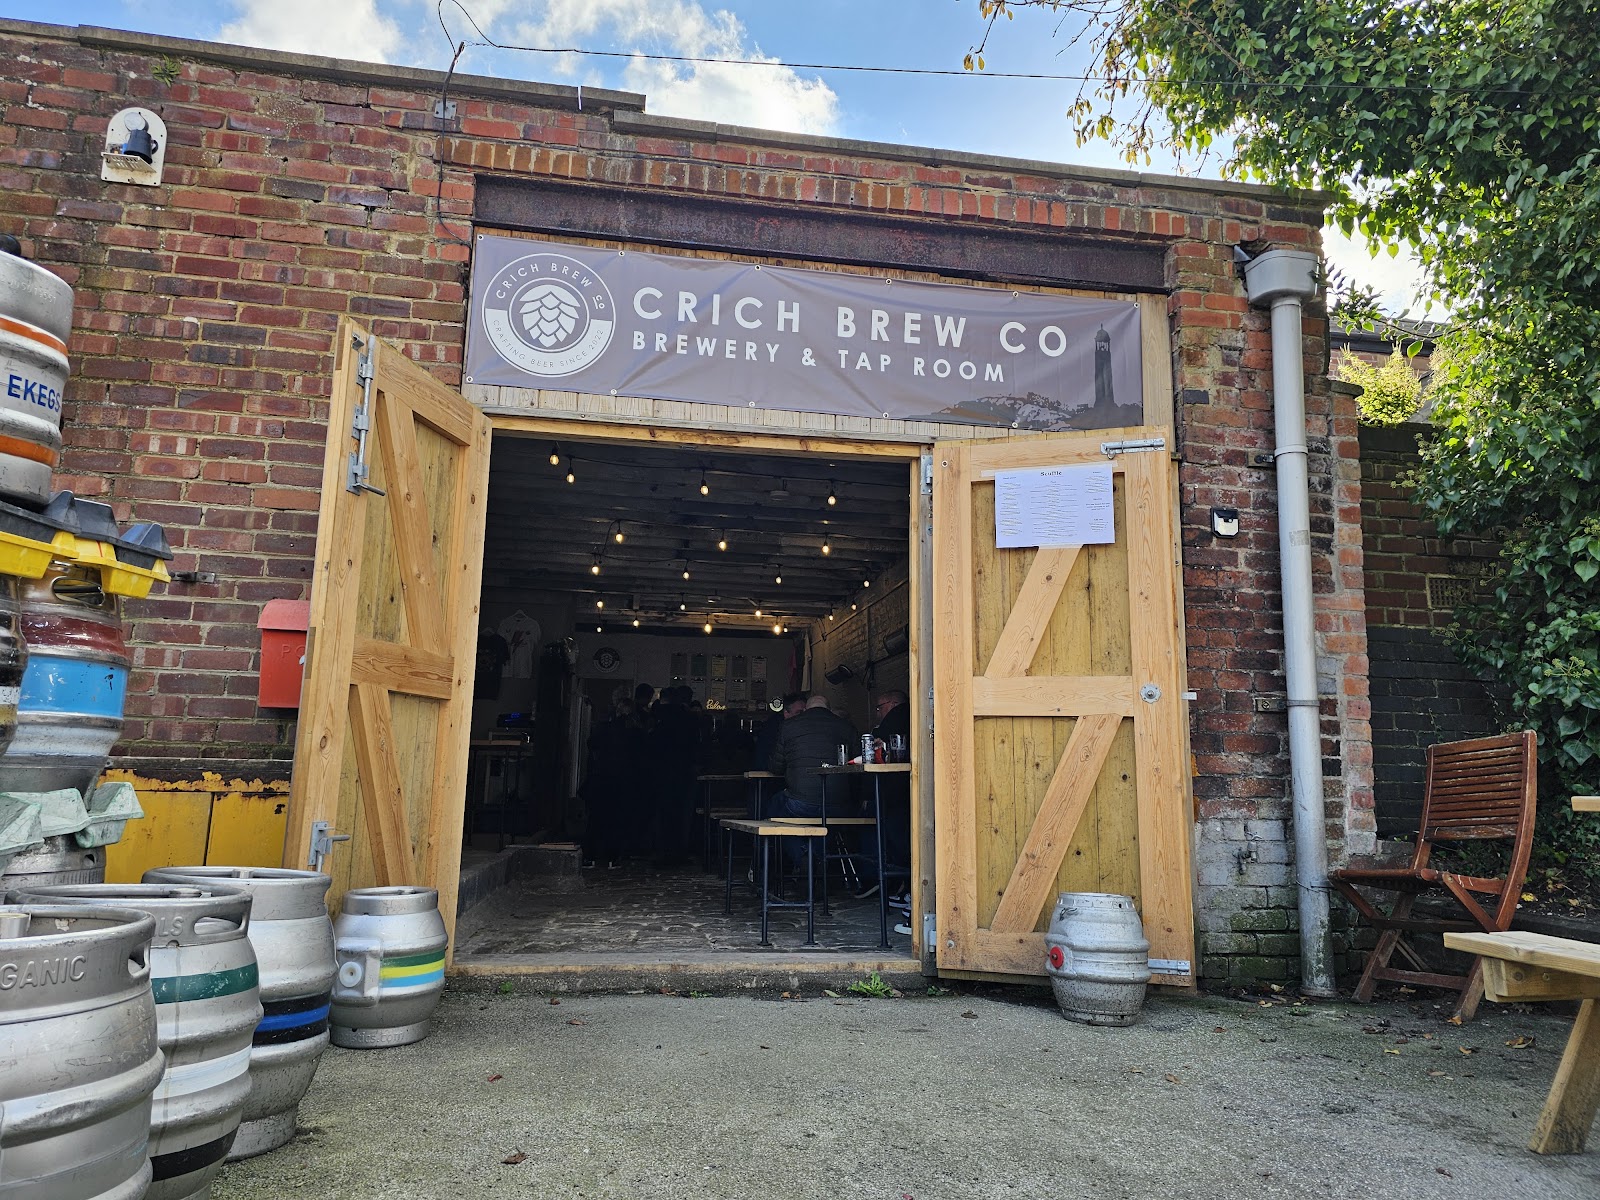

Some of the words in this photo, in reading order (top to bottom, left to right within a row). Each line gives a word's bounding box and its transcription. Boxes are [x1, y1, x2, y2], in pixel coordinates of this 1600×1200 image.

[496, 263, 539, 299] CRICH
[551, 263, 592, 288] BREW
[493, 319, 526, 360] CRAFTING
[530, 358, 554, 368] BEER
[560, 351, 587, 367] SINCE
[589, 329, 604, 350] 2022
[632, 287, 800, 333] CRICH
[837, 306, 967, 348] BREW
[999, 321, 1067, 358] CO
[632, 330, 780, 363] BREWERY
[801, 347, 816, 367] &
[838, 349, 892, 372] TAP
[913, 356, 1004, 383] ROOM
